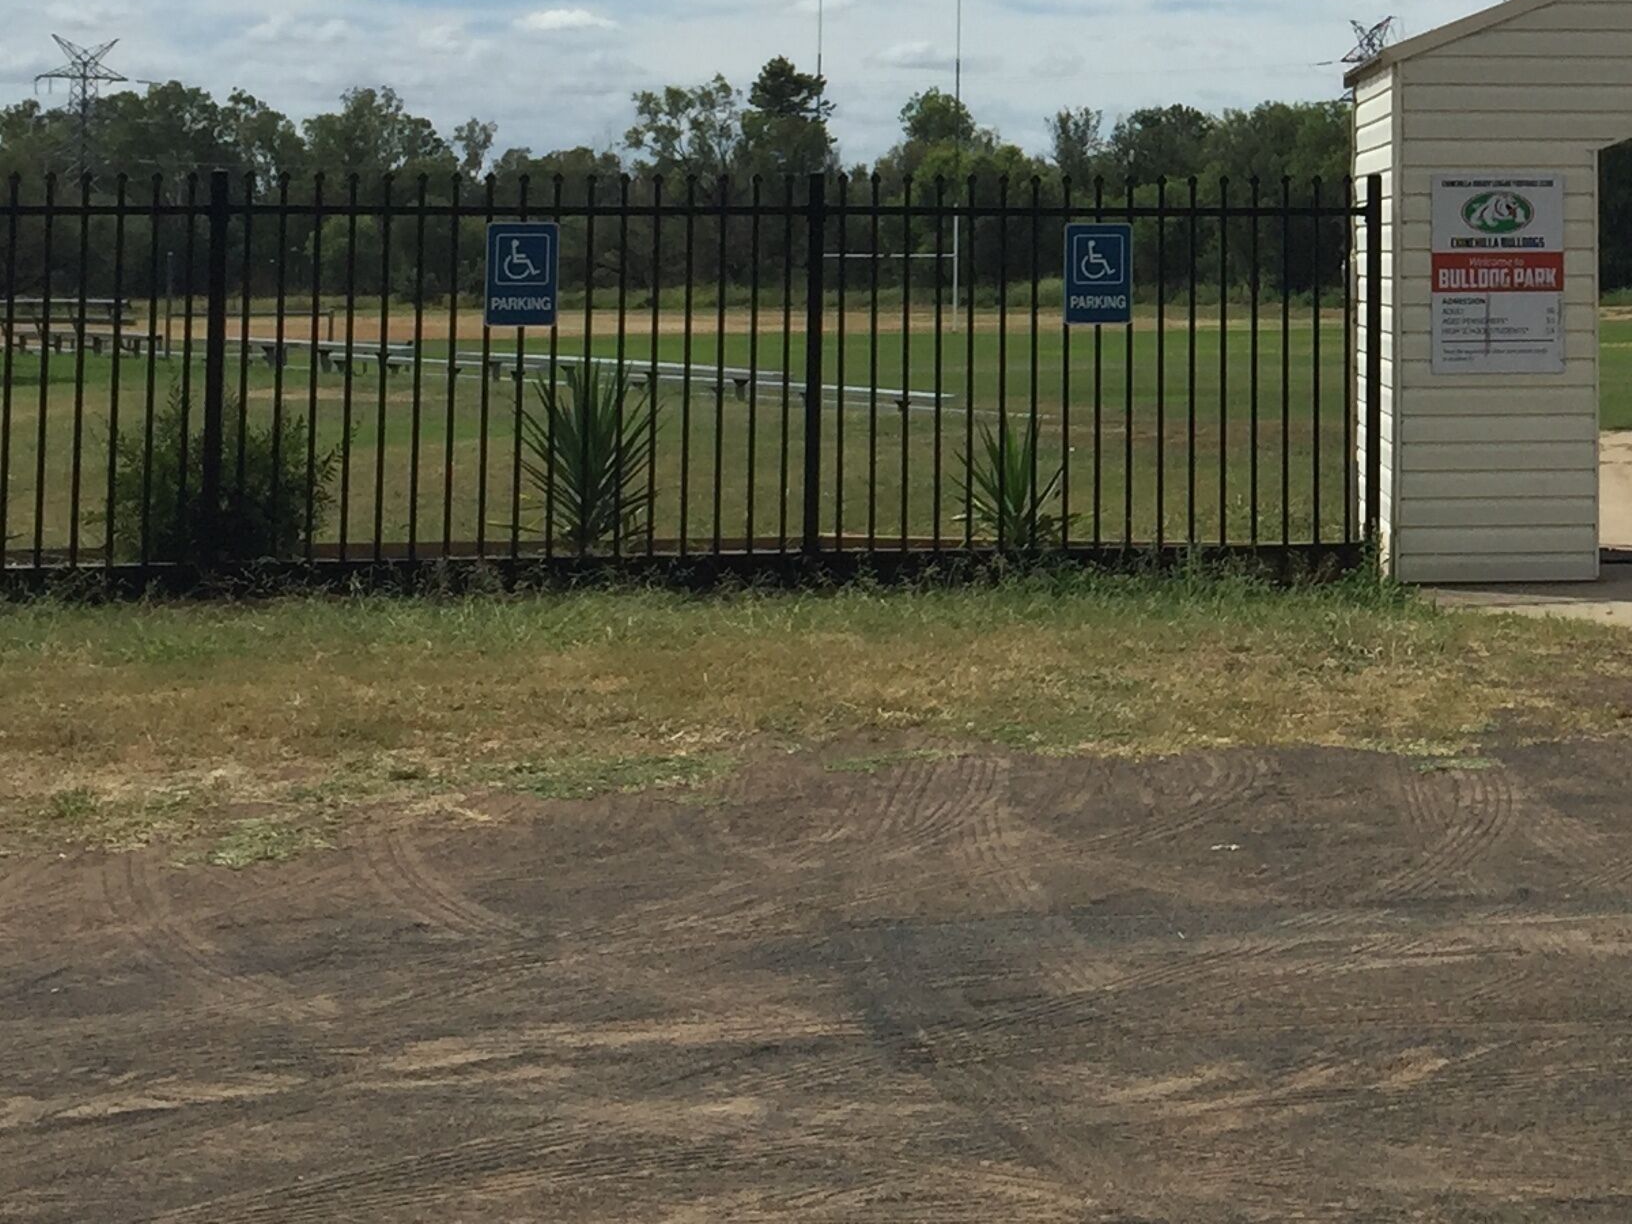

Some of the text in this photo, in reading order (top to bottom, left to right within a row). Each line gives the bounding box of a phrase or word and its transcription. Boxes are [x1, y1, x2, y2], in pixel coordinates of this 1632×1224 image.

[1439, 267, 1557, 289] BULLDOG PARK
[491, 296, 552, 311] PARKING
[1070, 295, 1127, 310] PARKING
